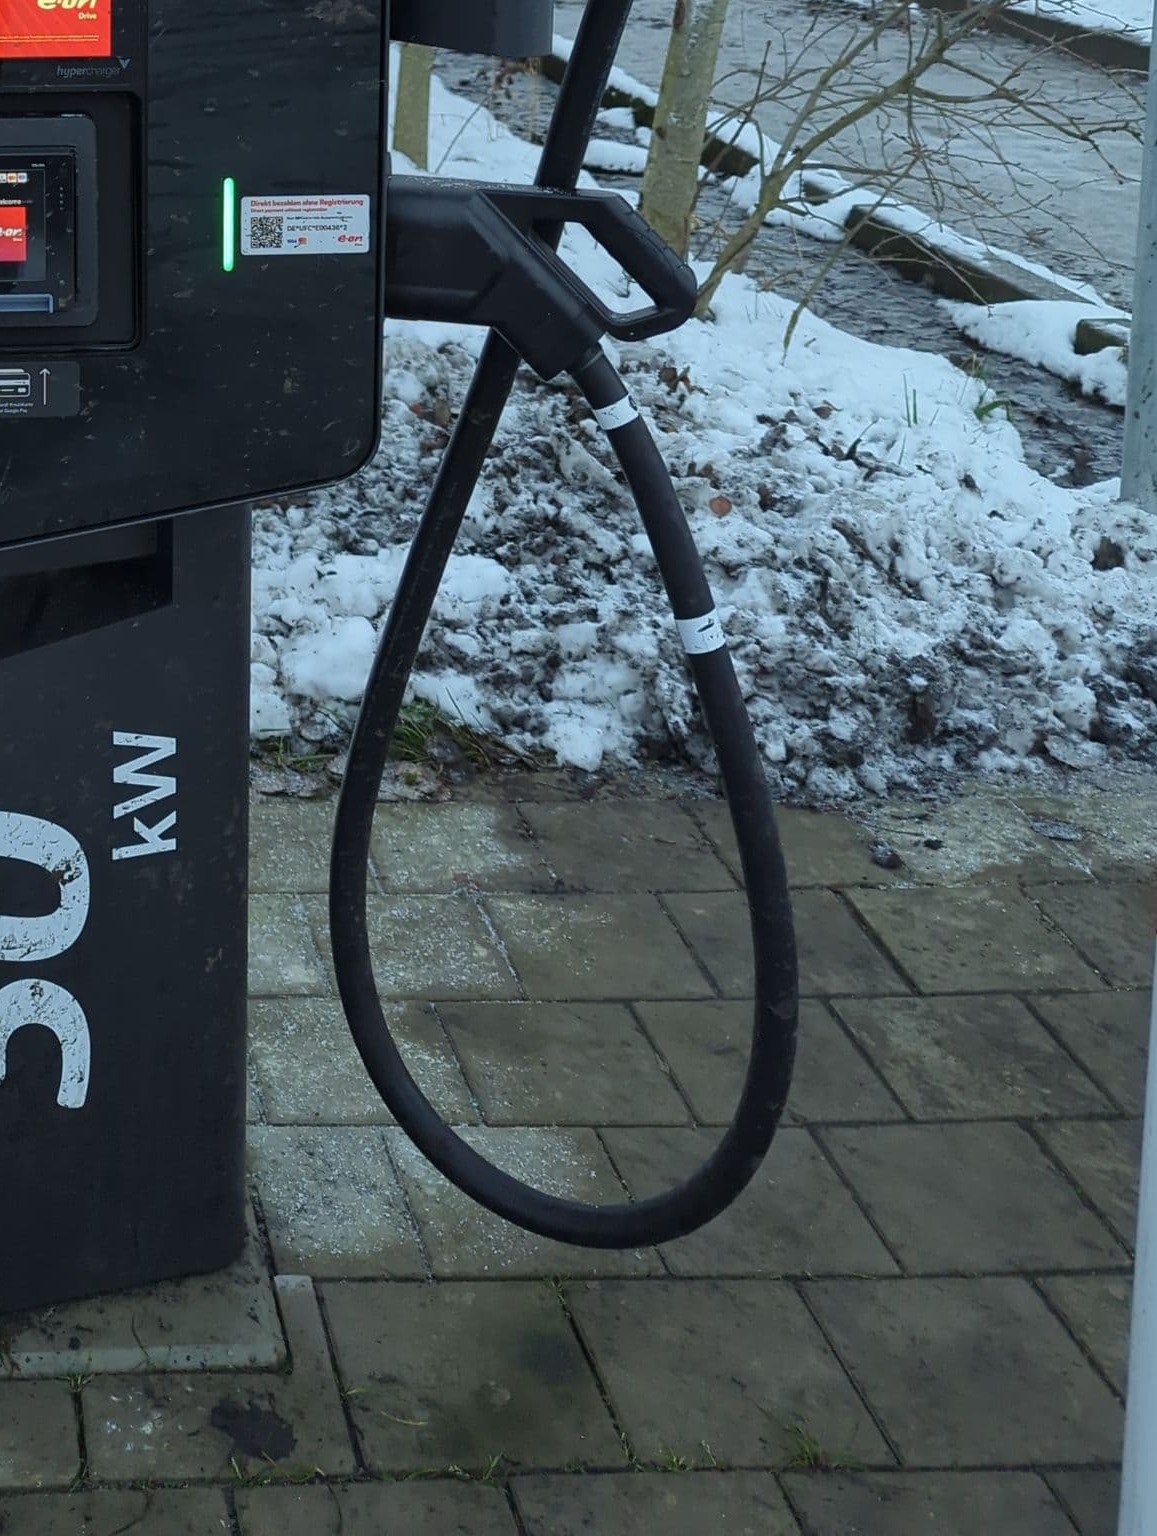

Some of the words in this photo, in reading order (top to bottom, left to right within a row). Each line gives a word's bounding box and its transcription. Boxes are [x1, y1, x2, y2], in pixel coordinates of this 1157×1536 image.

[78, 12, 97, 20] Drive
[320, 199, 364, 207] Registrierung
[112, 731, 177, 860] kW
